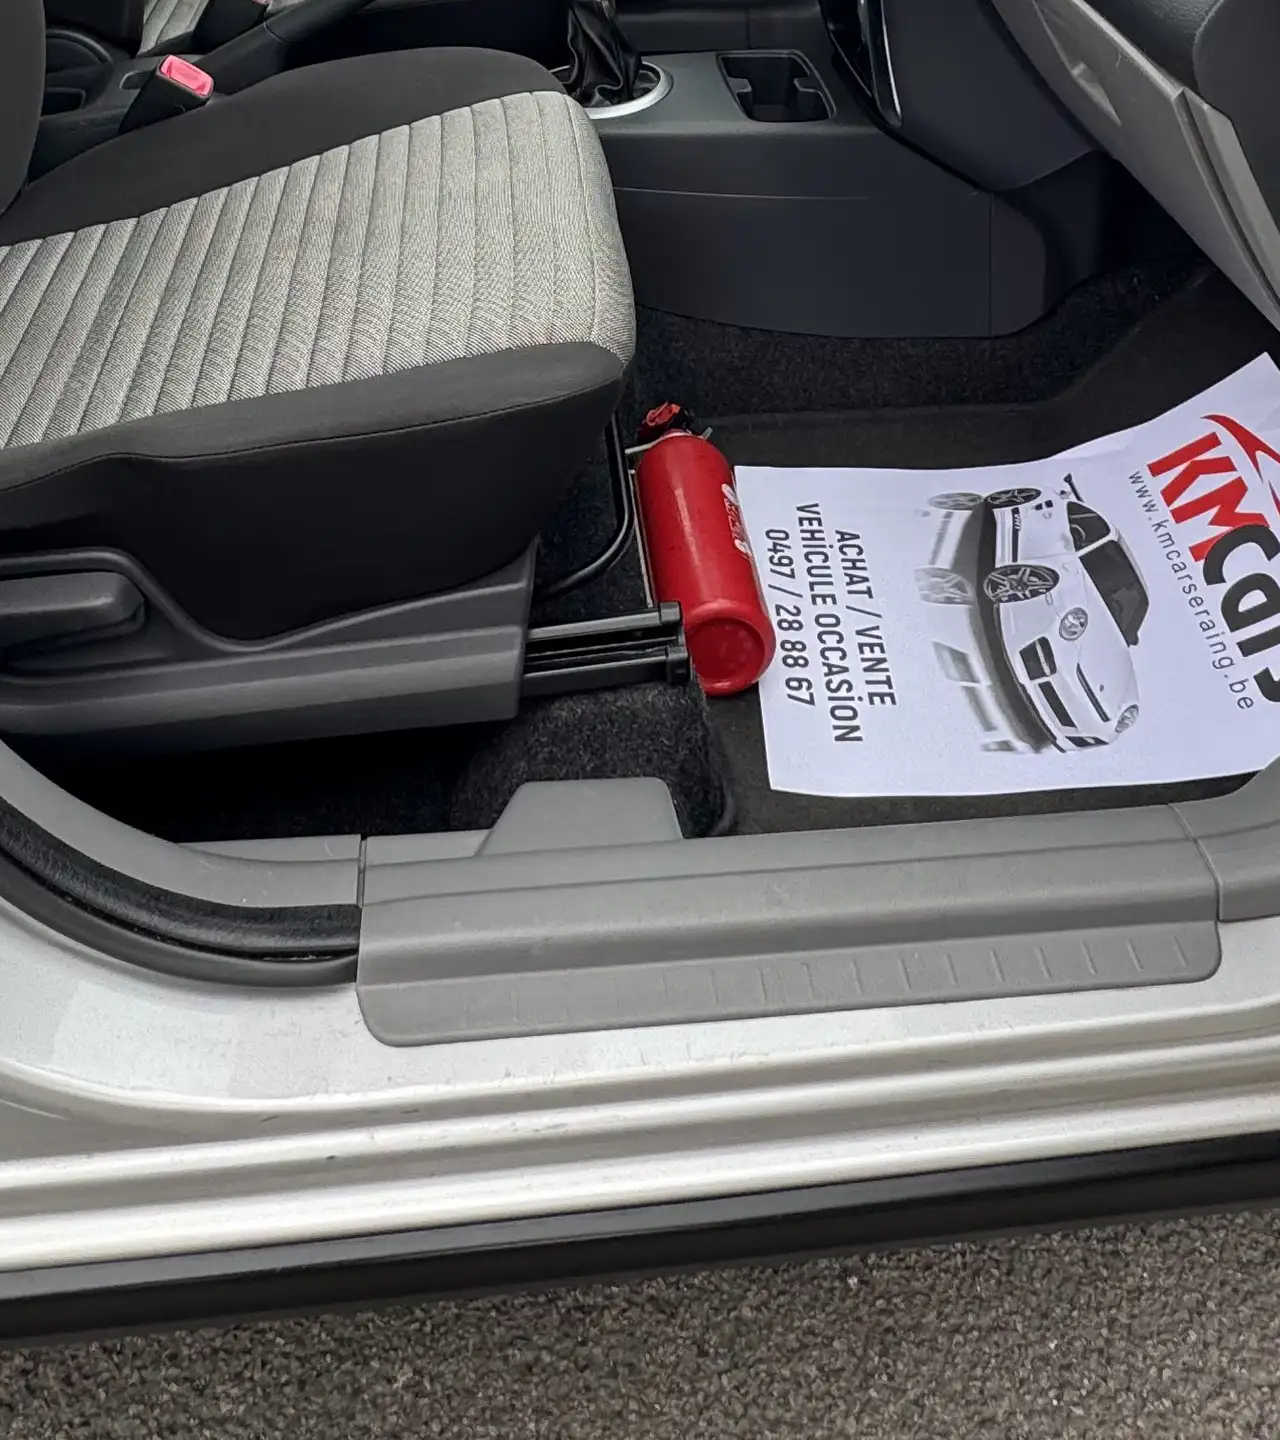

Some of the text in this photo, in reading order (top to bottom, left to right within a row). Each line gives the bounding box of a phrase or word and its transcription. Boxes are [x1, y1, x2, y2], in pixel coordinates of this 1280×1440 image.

[765, 528, 816, 707] 0497 / 28 88 67
[834, 529, 897, 706] ACHAT / VENTE
[1127, 469, 1255, 710] www.kmcarseraing.be
